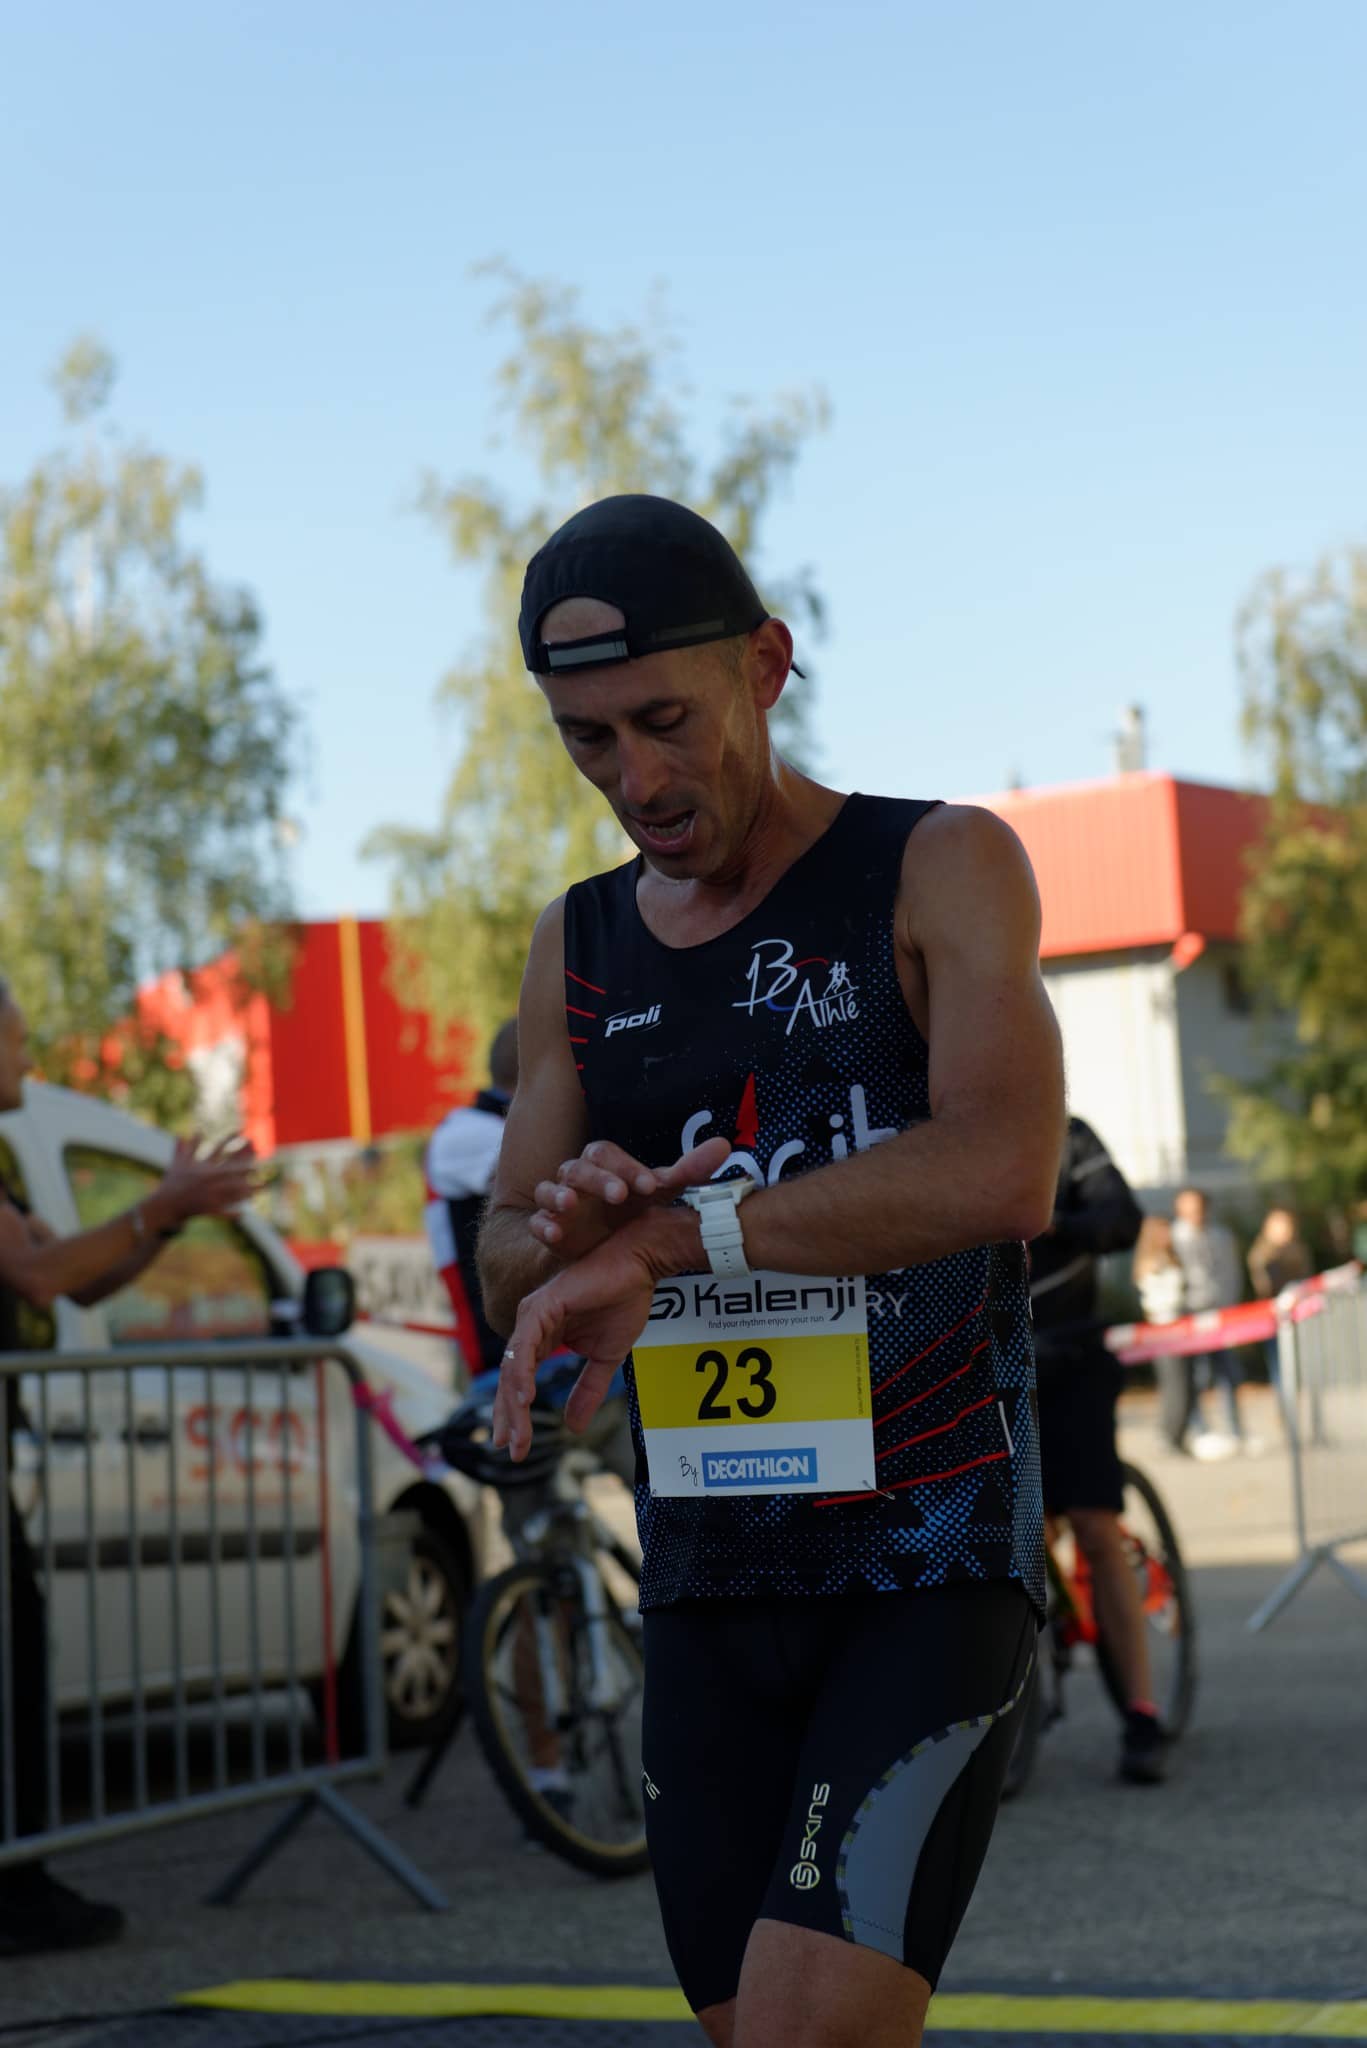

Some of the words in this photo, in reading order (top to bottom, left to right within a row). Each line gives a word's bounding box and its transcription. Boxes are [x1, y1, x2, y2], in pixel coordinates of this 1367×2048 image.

[604, 1004, 662, 1038] poli
[694, 1277, 857, 1320] Kalenji
[708, 1320, 722, 1329] find
[722, 1320, 738, 1330] your
[739, 1319, 766, 1329] rhythm
[767, 1317, 788, 1327] enjoy
[790, 1315, 808, 1325] your
[810, 1315, 824, 1323] run
[695, 1347, 777, 1421] 23
[679, 1455, 698, 1486] By
[707, 1455, 808, 1480] DECATHLON
